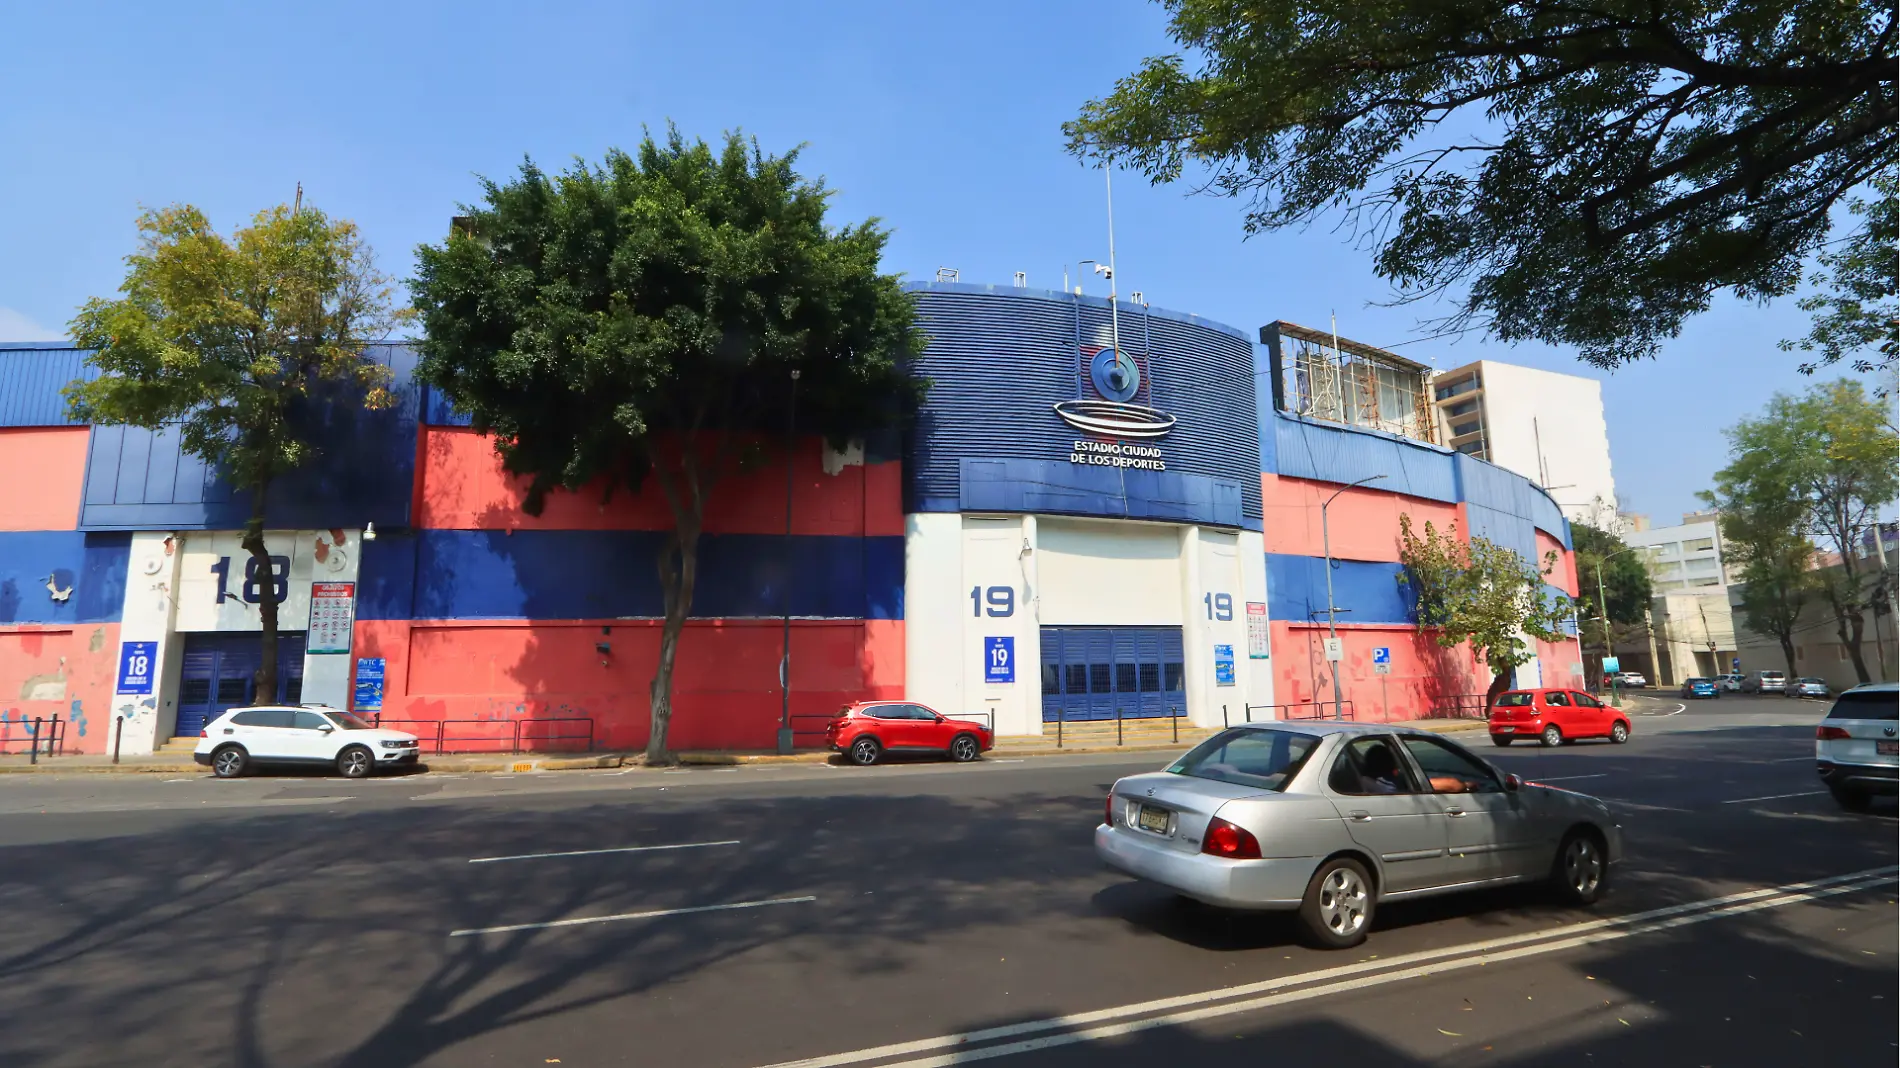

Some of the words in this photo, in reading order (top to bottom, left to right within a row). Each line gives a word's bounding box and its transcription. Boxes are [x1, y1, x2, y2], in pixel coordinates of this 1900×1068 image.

[1074, 440, 1120, 454] ESTADIO
[1122, 445, 1162, 458] CIUDAD
[1070, 453, 1086, 463] DE
[1088, 454, 1110, 465] LOS
[1112, 456, 1166, 470] DEPORTES
[211, 555, 290, 604] 18
[970, 585, 1015, 618] 19
[1204, 592, 1233, 621] 19
[991, 648, 1008, 666] 19
[1374, 648, 1384, 661] P
[128, 655, 148, 676] 18
